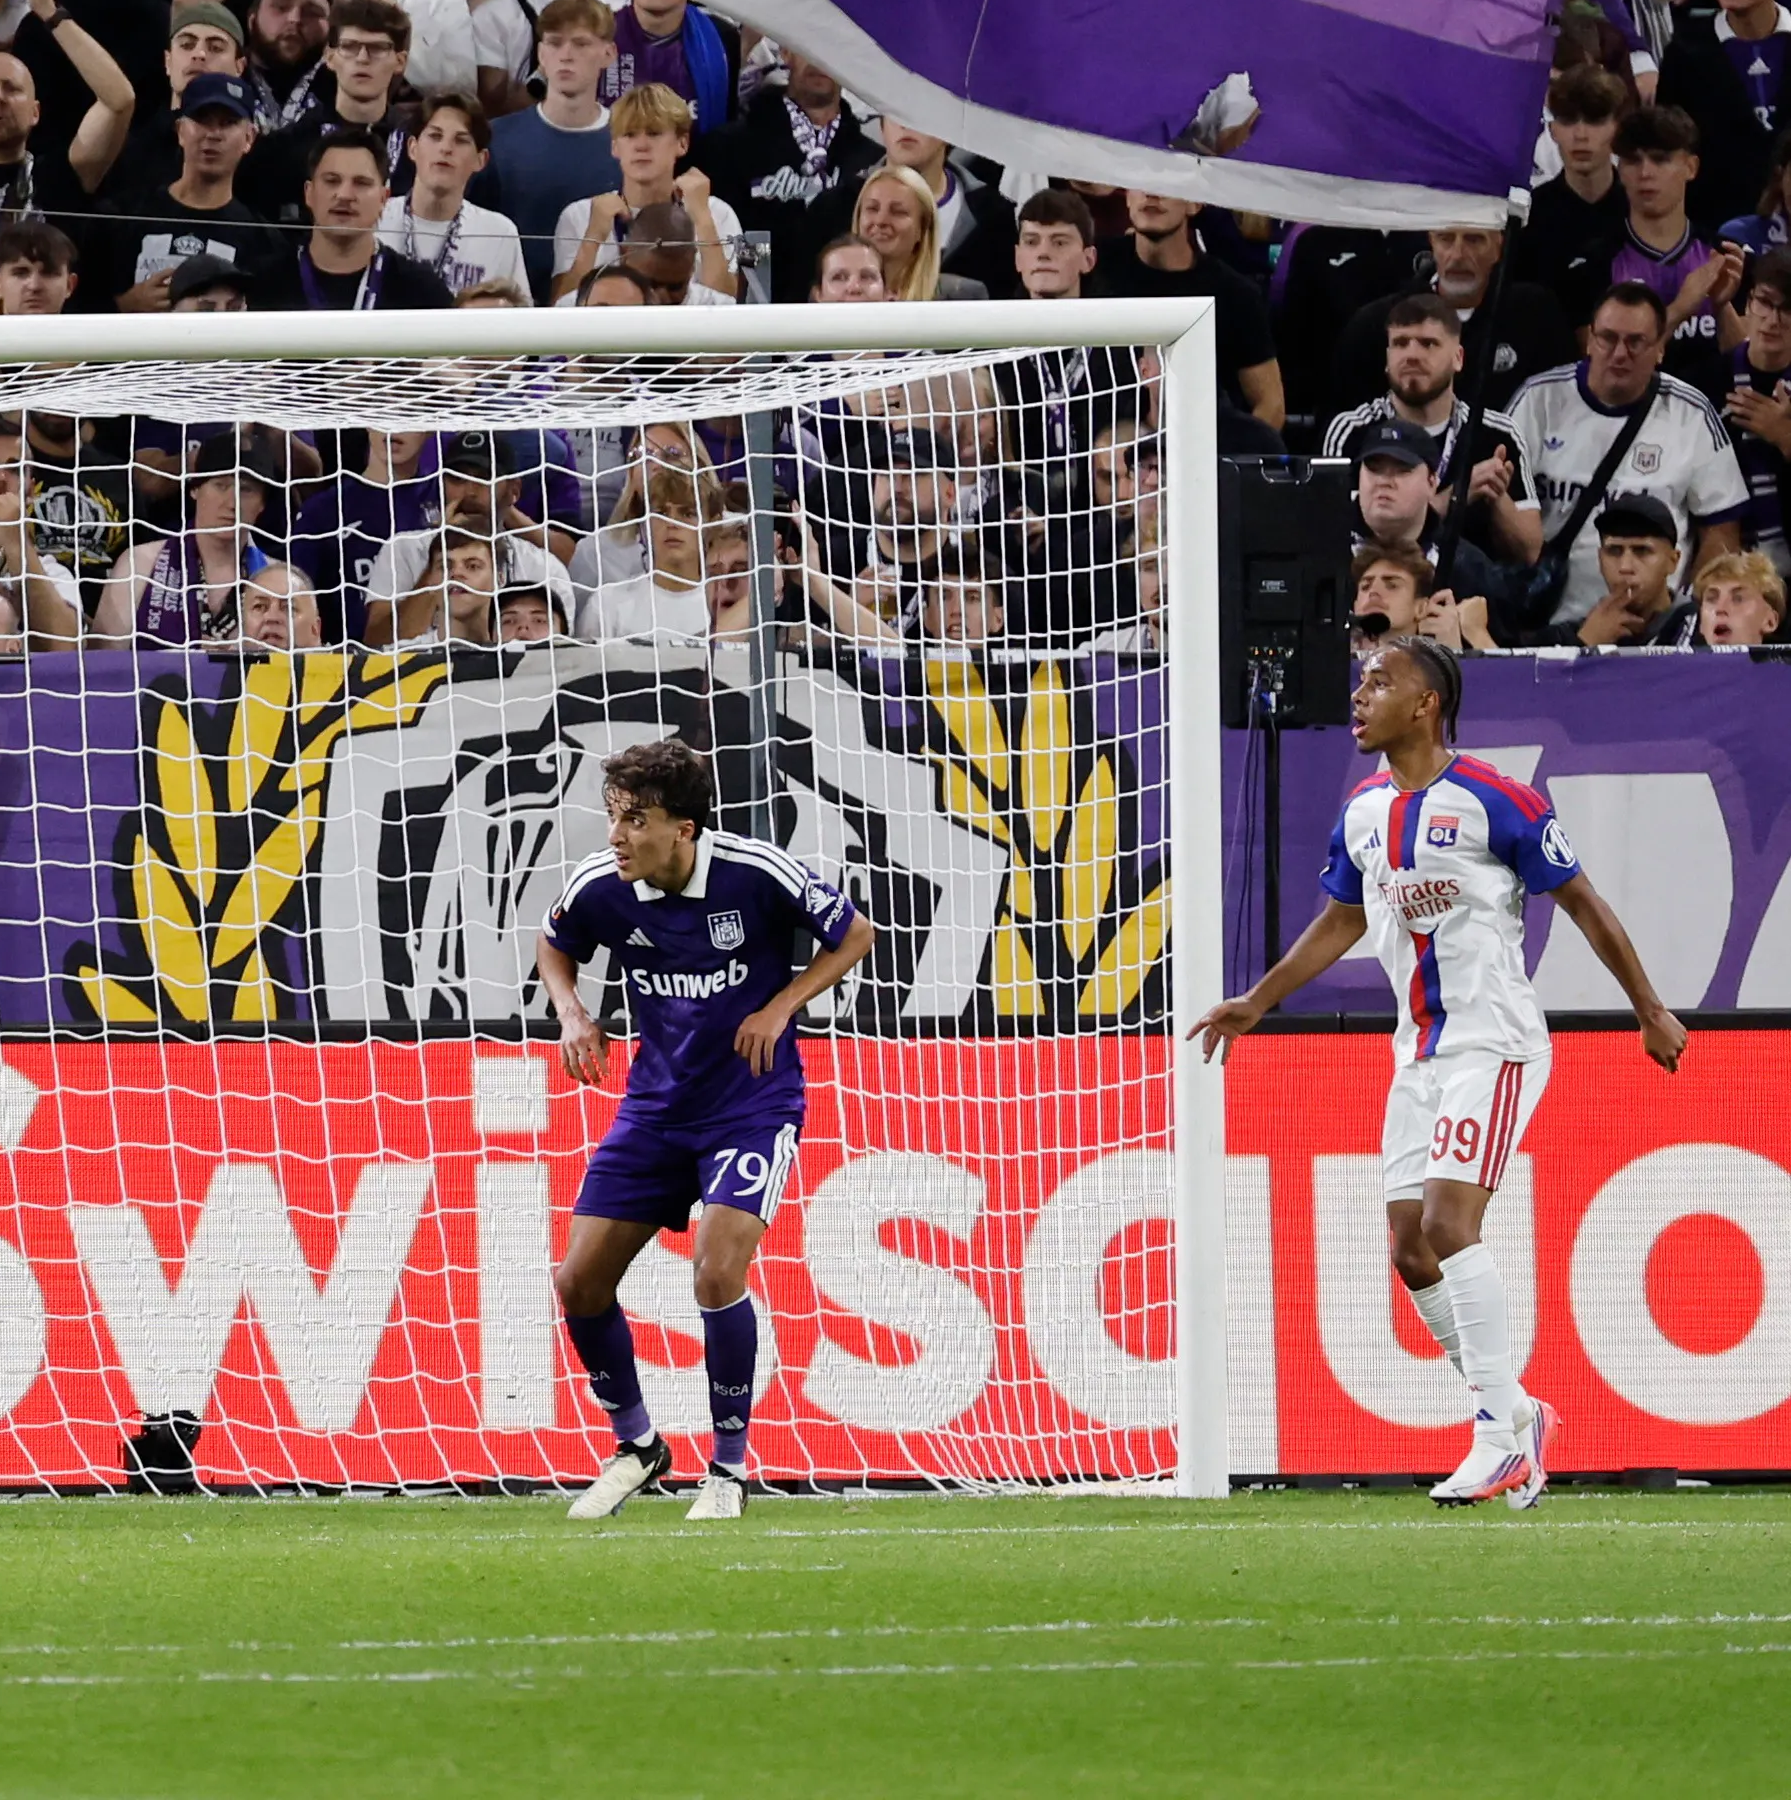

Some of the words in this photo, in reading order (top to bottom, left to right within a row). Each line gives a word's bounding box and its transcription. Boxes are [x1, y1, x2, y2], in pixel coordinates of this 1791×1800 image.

[1429, 827, 1454, 844] OL
[1402, 898, 1453, 921] BETTER
[632, 959, 748, 999] Sunweb
[1431, 1115, 1482, 1164] 99
[709, 1147, 773, 1202] 79
